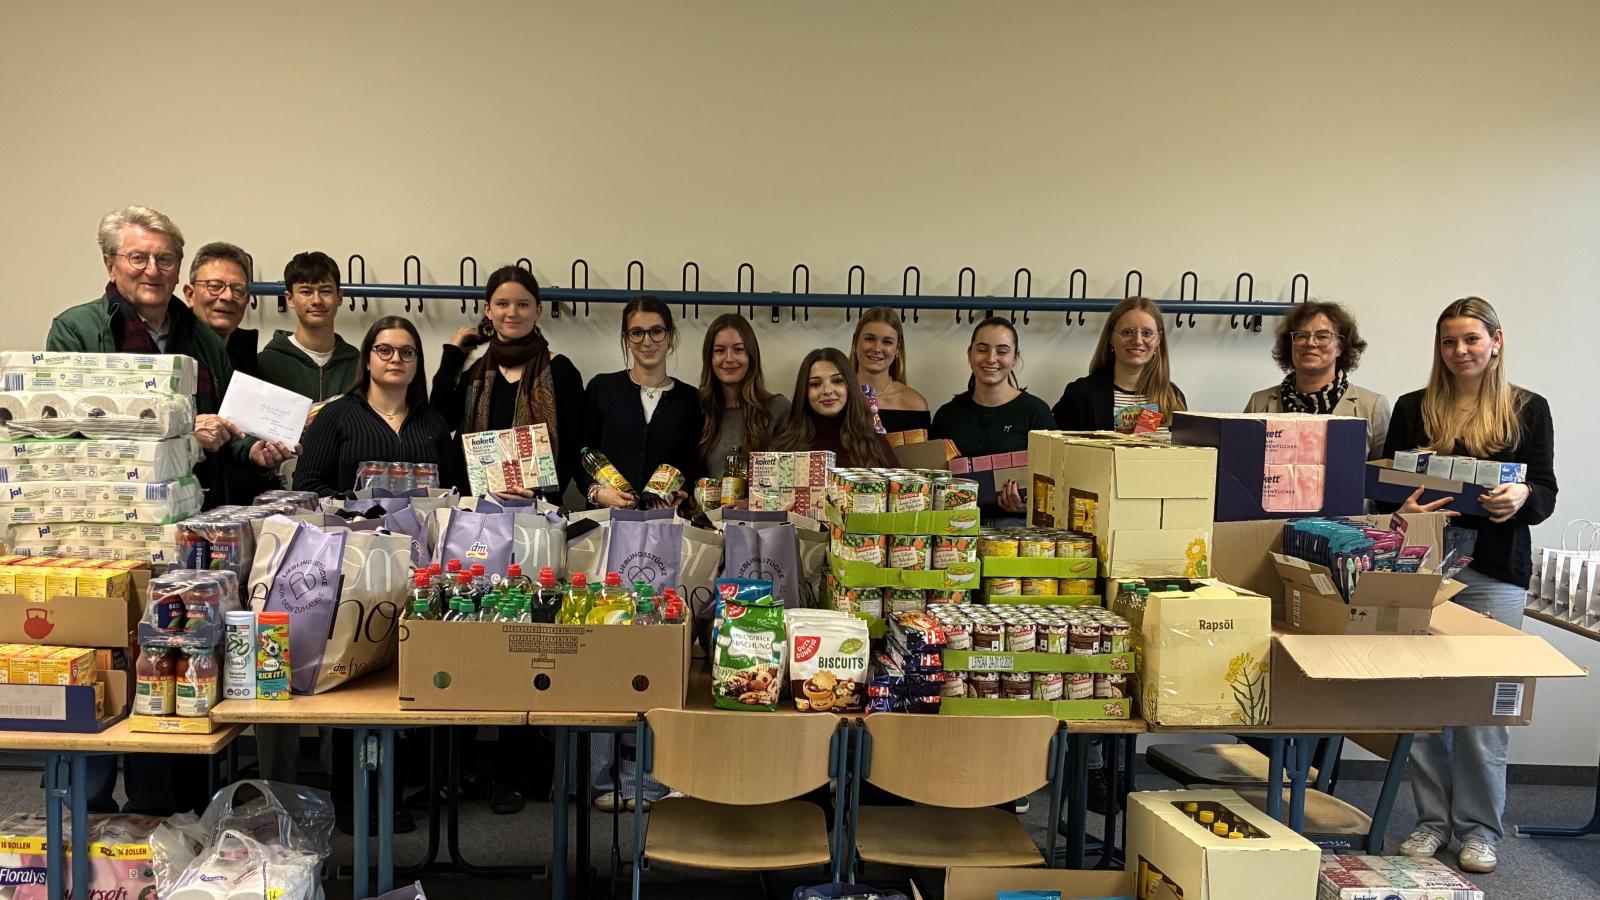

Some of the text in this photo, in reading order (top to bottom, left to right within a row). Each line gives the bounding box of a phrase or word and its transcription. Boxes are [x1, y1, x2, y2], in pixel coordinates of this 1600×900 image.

[31, 353, 44, 365] ja!
[145, 377, 157, 389] ja!
[471, 436, 496, 446] kokett
[13, 444, 26, 457] ja!
[755, 457, 776, 466] kokett
[127, 467, 139, 480] ja!
[9, 486, 22, 500] ja!
[125, 508, 138, 521] ja!
[38, 525, 51, 538] ja!
[471, 543, 486, 552] dm
[619, 551, 667, 577] LIEBLINGSSTÜCKE
[737, 556, 784, 579] LIEBLINSTÜCKE
[282, 559, 328, 587] LIEBLINGSSTÜCKE
[281, 599, 294, 612] DEIN
[1199, 619, 1234, 633] Rapsöl
[818, 656, 864, 670] BISCUITS
[124, 848, 147, 856] ROLLEN
[0, 868, 46, 886] Floralys
